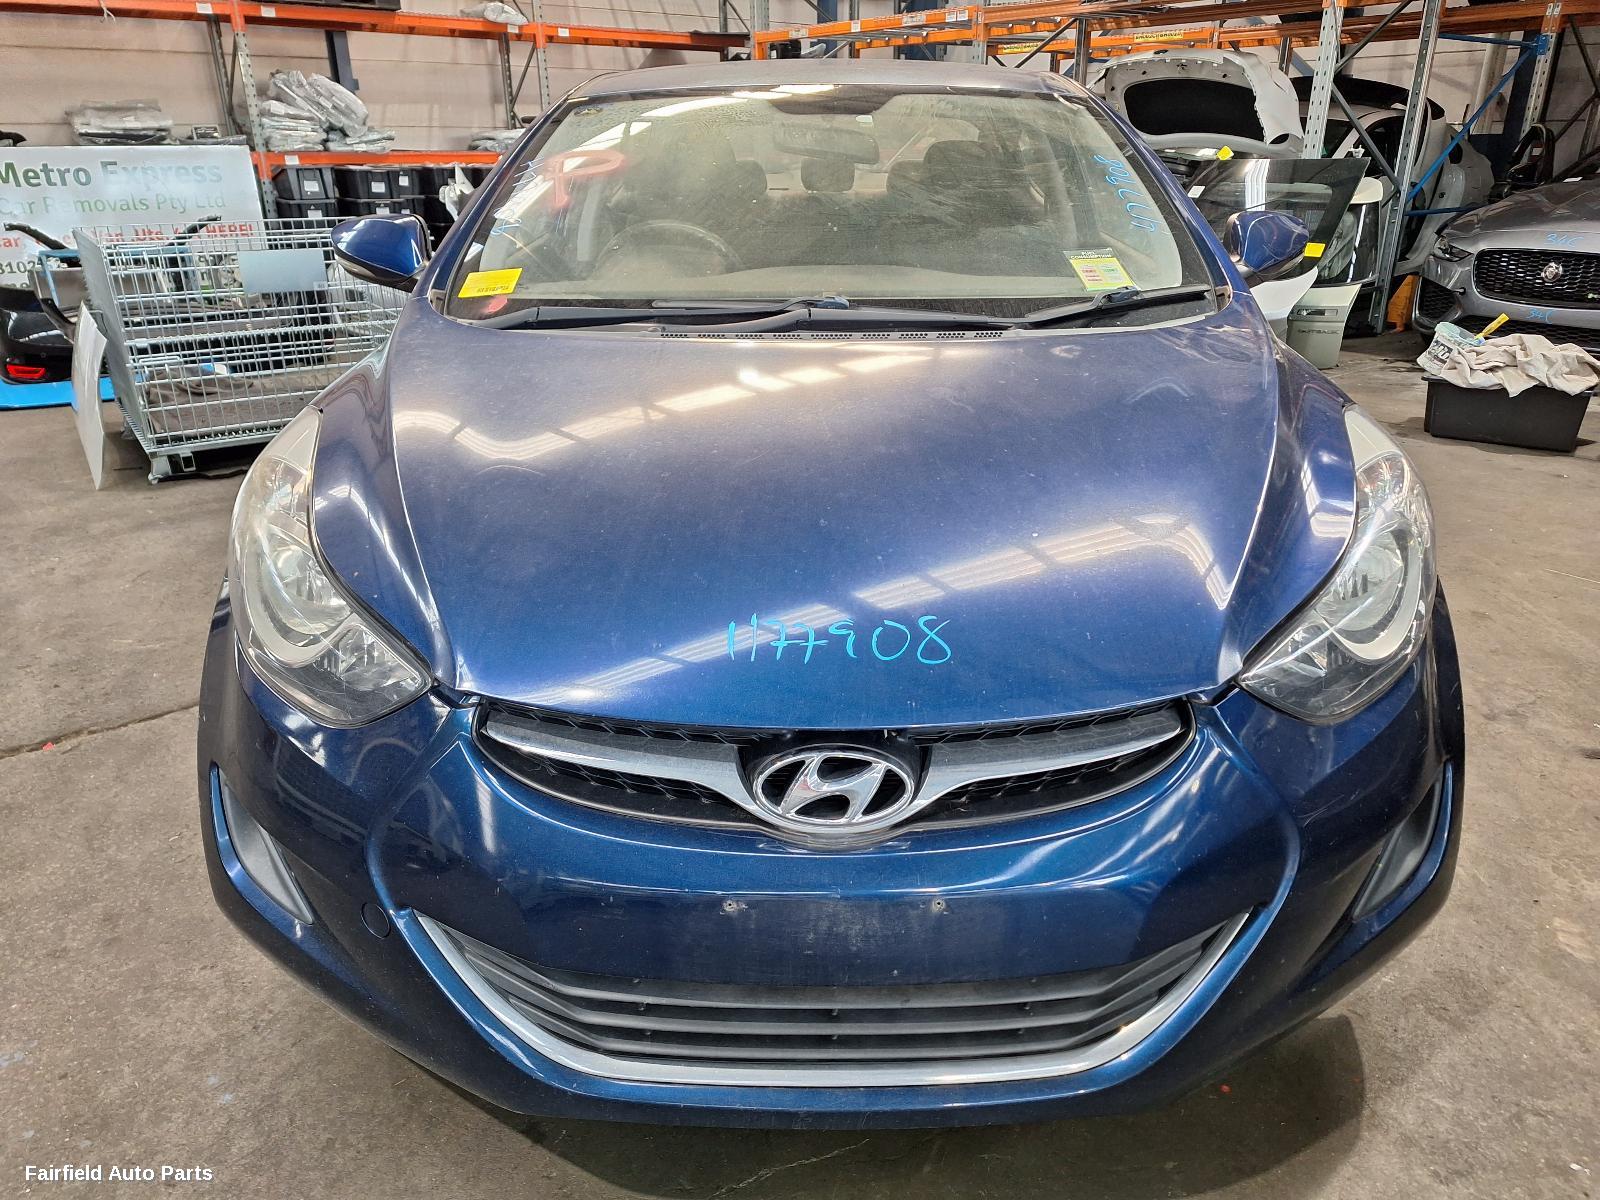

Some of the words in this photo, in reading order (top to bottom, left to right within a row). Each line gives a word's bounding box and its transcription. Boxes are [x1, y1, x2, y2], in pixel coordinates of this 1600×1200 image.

[0, 160, 92, 188] Metro
[100, 160, 223, 191] Express
[156, 193, 187, 214] Pty
[196, 191, 226, 209] Ltd
[0, 235, 21, 248] ar
[727, 612, 953, 665] 1177908
